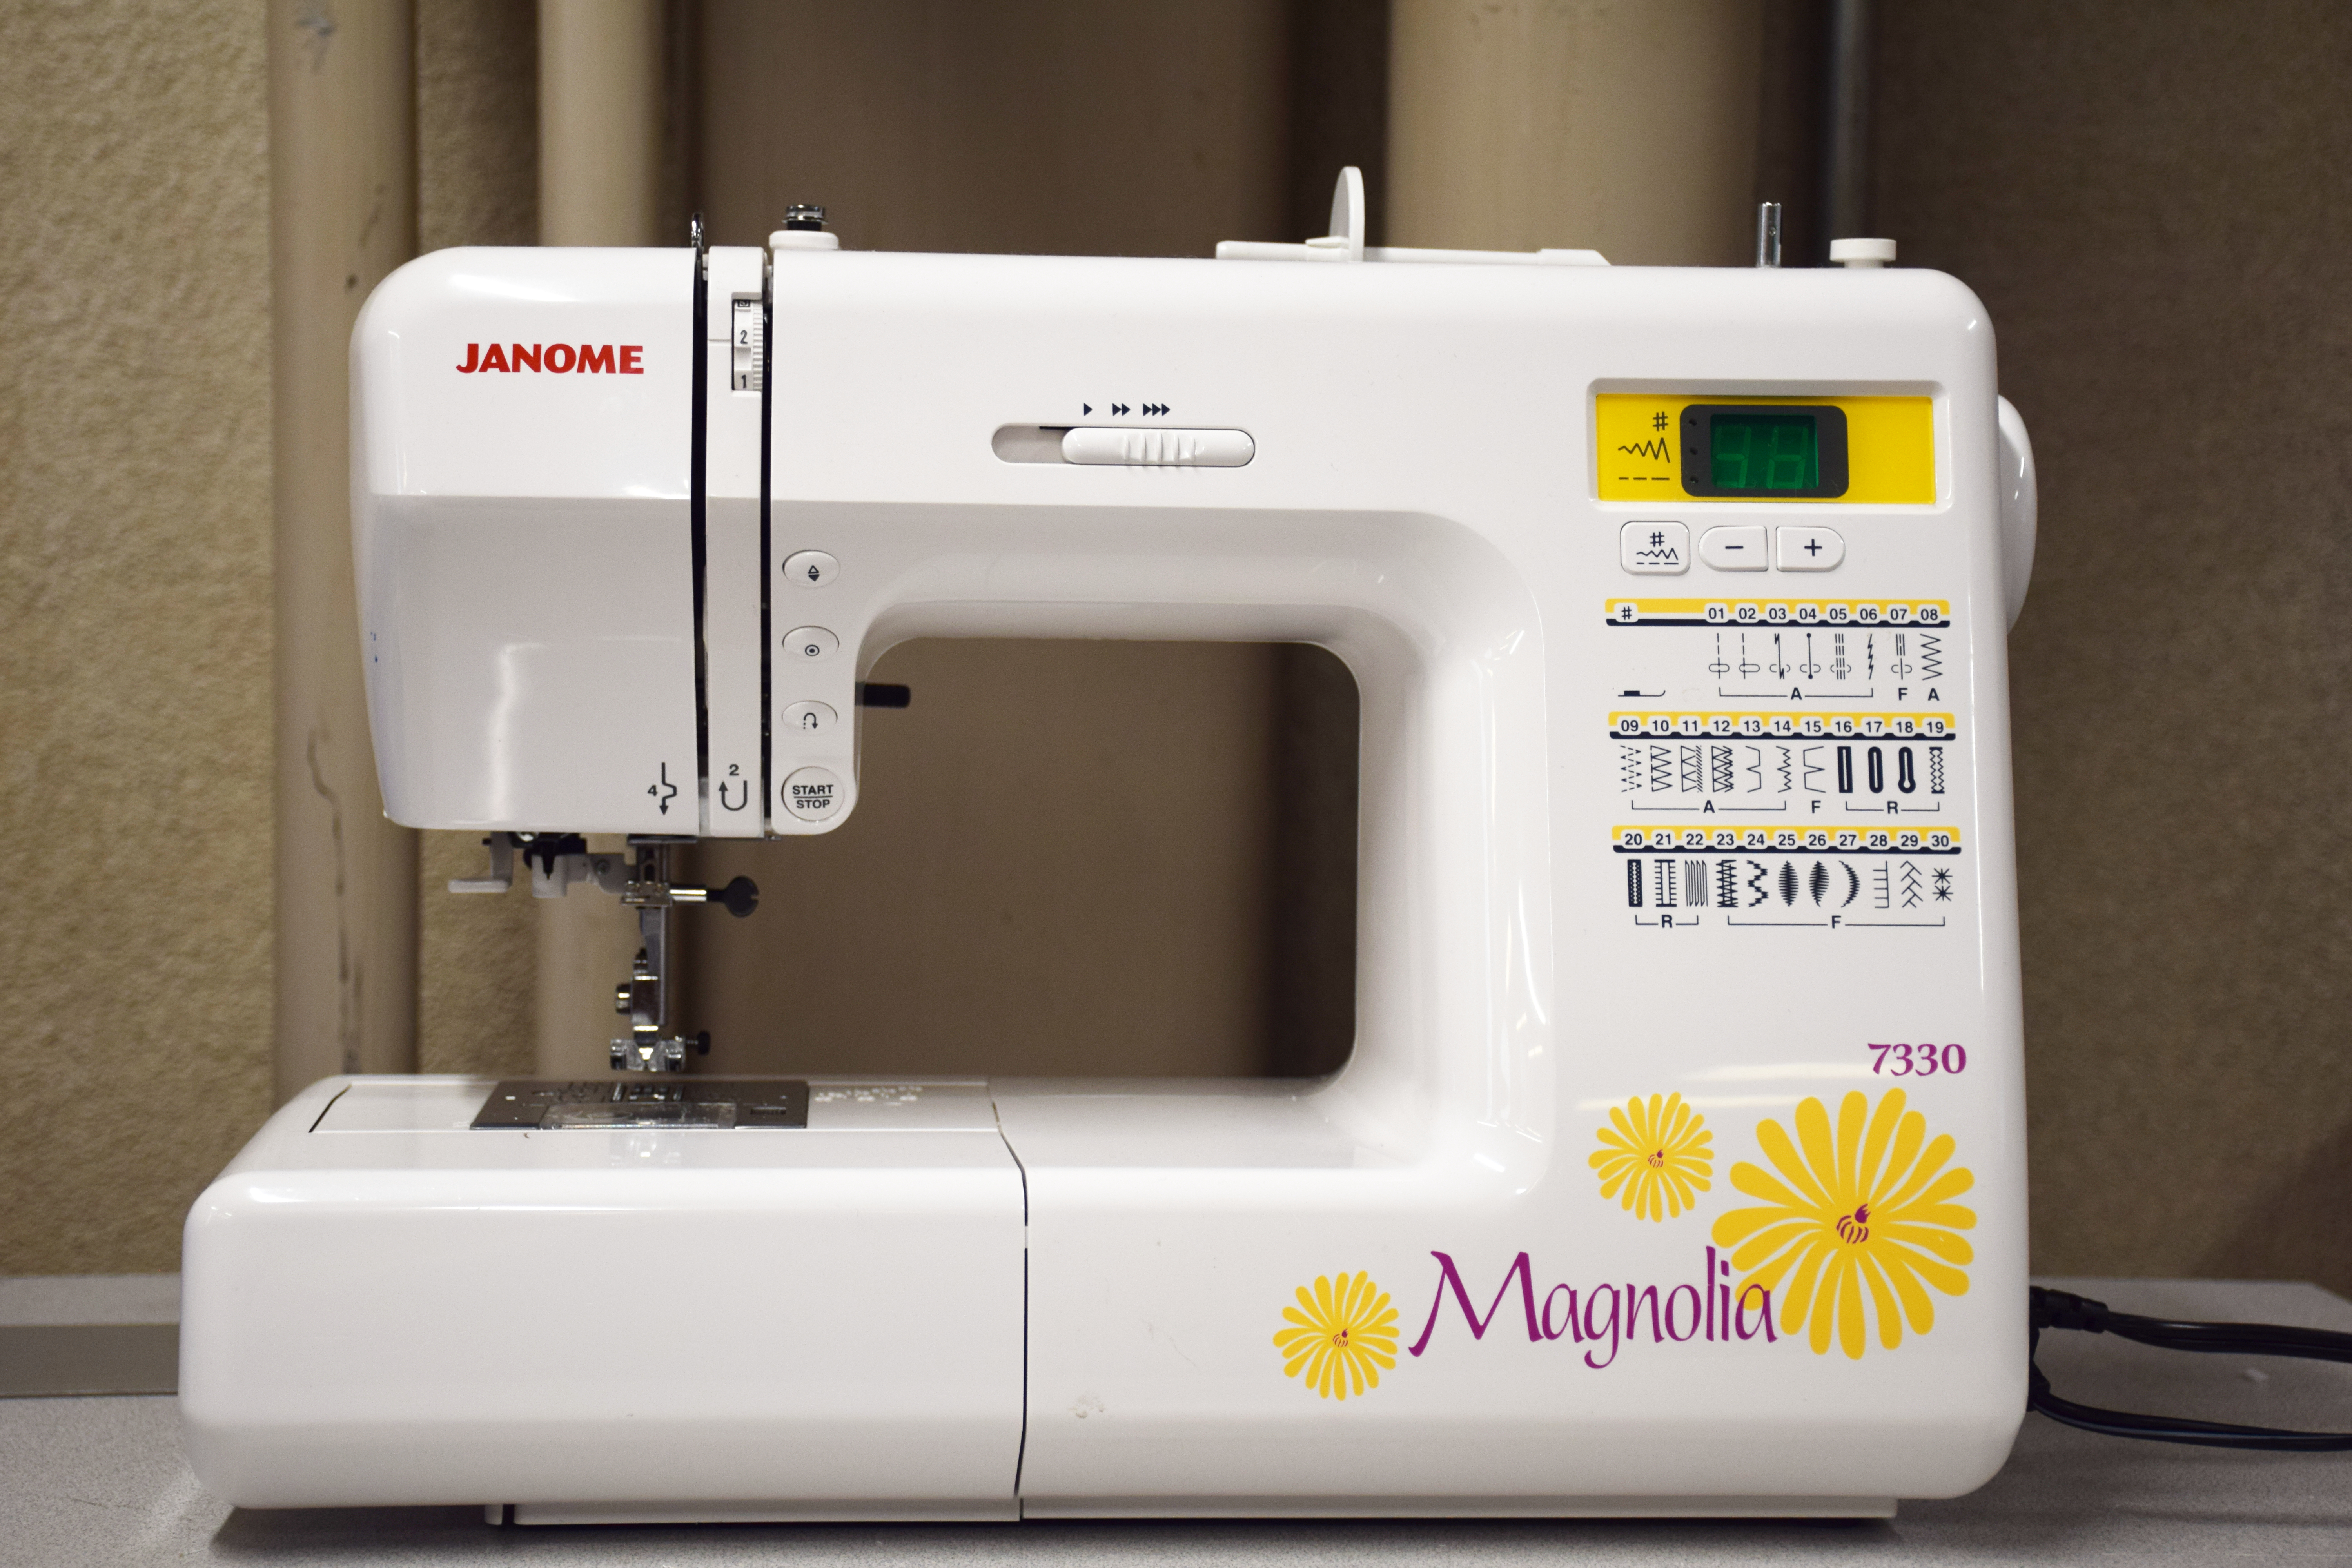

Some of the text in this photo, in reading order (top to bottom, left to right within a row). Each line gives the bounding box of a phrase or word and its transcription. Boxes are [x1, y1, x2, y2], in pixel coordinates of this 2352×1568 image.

[740, 330, 748, 345] 2
[456, 343, 644, 374] JANOME
[741, 374, 747, 389] 1
[1708, 608, 1724, 619] 01
[1739, 608, 1756, 620] 02
[1769, 608, 1786, 620] 03
[1799, 608, 1817, 620] 04
[1829, 608, 1847, 620] 05
[1860, 608, 1877, 621] 06
[1890, 608, 1907, 621] 07
[1920, 608, 1938, 621] 08
[1791, 687, 1940, 701] A F A
[1621, 720, 1944, 734] 09 10 11 12 13 14 15 16 17 18 19
[729, 764, 739, 776] 2
[647, 784, 658, 797] 4
[792, 784, 834, 795] START
[796, 799, 830, 809] STOP
[1703, 800, 1898, 814] A F R
[1625, 833, 1949, 847] 20 21 22 23 24 25 26 27 28 29 30
[1661, 914, 1842, 929] R F
[1868, 1043, 1966, 1076] 7330
[1408, 1245, 1777, 1369] Magnolia
